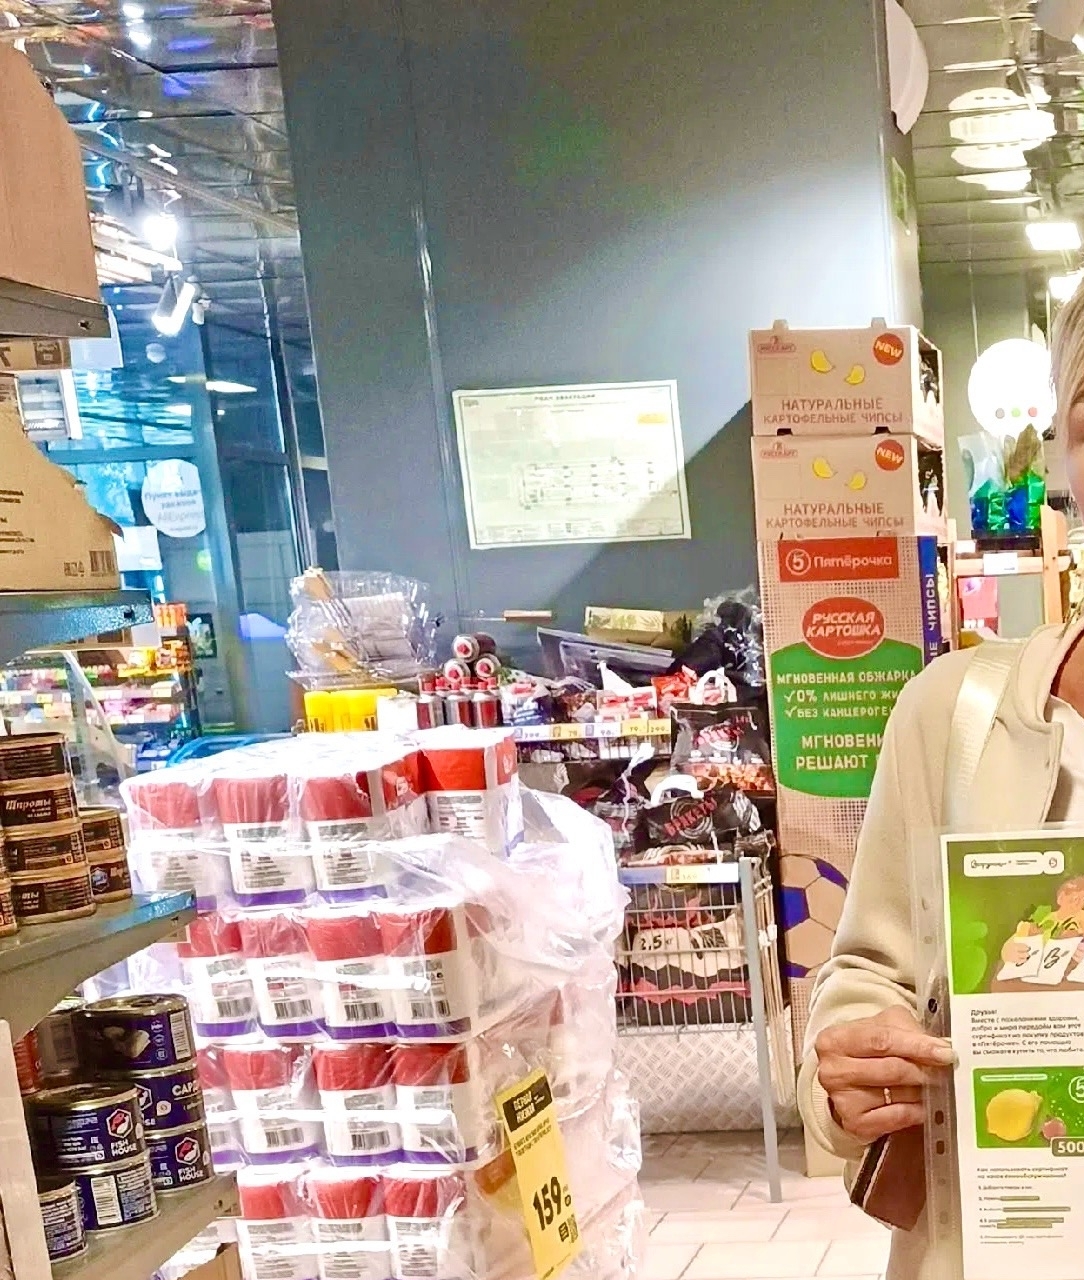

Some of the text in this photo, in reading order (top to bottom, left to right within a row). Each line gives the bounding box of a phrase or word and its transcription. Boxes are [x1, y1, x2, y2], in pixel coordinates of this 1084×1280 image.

[876, 341, 902, 358] NEW
[782, 398, 883, 411] НАТУРАЛЬНЫЕ
[764, 412, 903, 424] КАРТОФЕЛЬНЫЕ ЧИПСЫ
[877, 448, 903, 464] NEW
[784, 502, 884, 515] НАТУРАЛЬНЫЕ
[766, 516, 904, 529] КАРТОФЕЛЬНЫЕ ЧИПСЫ
[814, 556, 892, 570] Пятёрочка
[925, 574, 938, 631] ЧИПСЫ
[812, 611, 875, 624] РУССКАЯ
[806, 625, 881, 638] КАРТОШКА
[777, 672, 854, 684] МГНОВЕННАЯ
[797, 690, 817, 702] 0%
[823, 690, 876, 701] ЛИШНЕГО
[797, 706, 892, 718] БЕЗ КАНЦЕРОГЕ
[796, 755, 868, 770] РЕШАЮТ
[6, 798, 51, 811] Шпроты
[111, 1139, 128, 1150] FISH
[112, 1144, 137, 1157] HOUSE
[178, 1165, 196, 1176] FISH
[179, 1170, 204, 1182] HOUSE
[533, 1176, 561, 1231] 159
